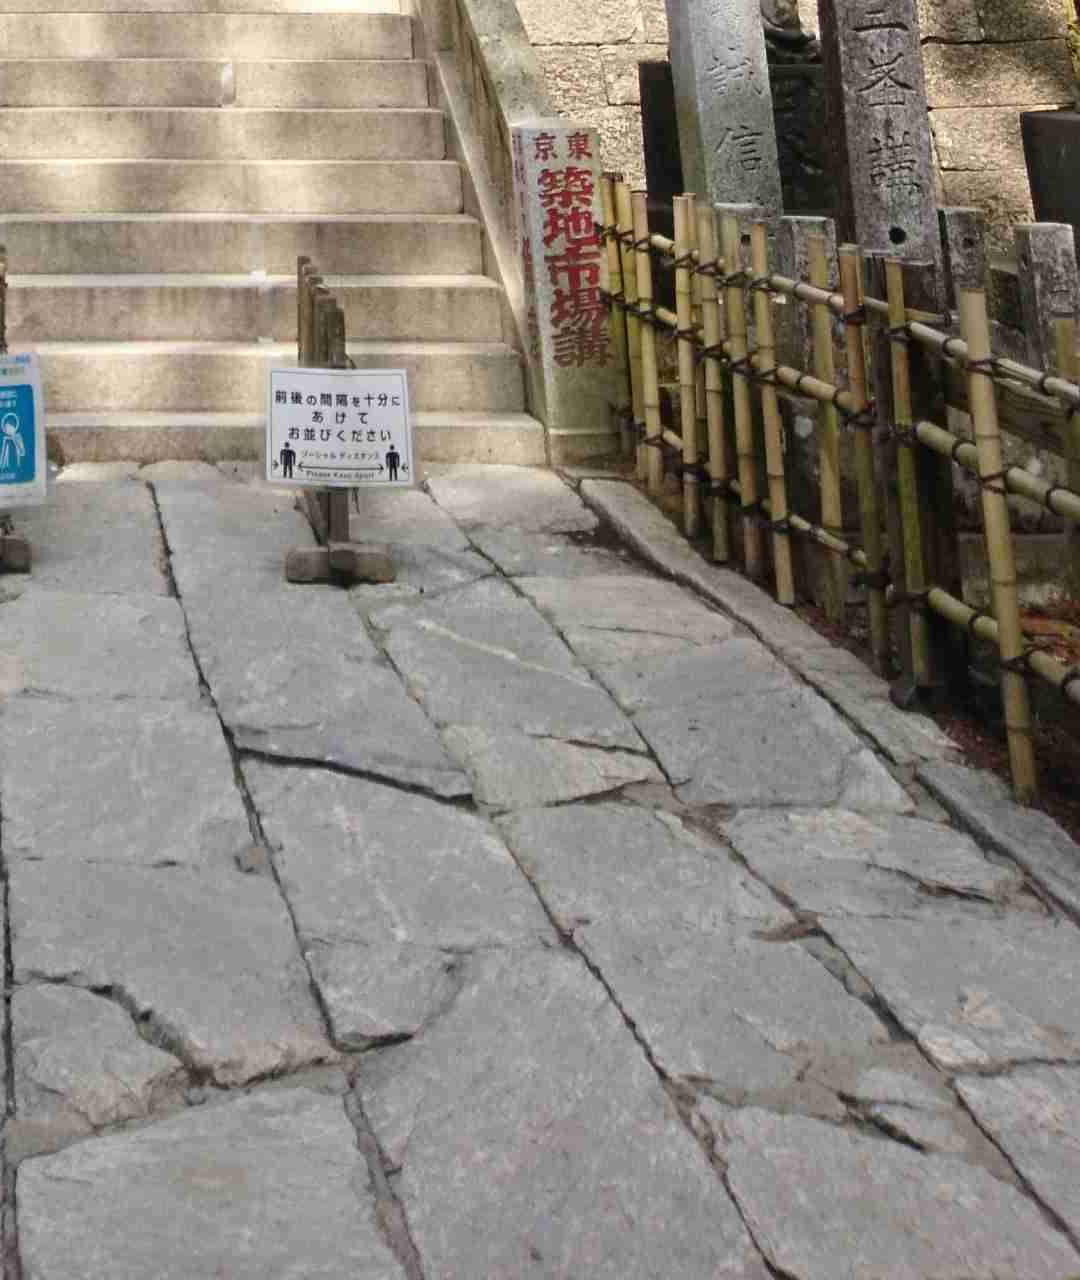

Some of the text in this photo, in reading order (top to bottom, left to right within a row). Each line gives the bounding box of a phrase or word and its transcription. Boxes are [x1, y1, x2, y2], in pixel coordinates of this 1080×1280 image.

[275, 390, 401, 408] 前後の間隔を十分に
[312, 411, 370, 425] あけて
[288, 426, 392, 443] お並びください
